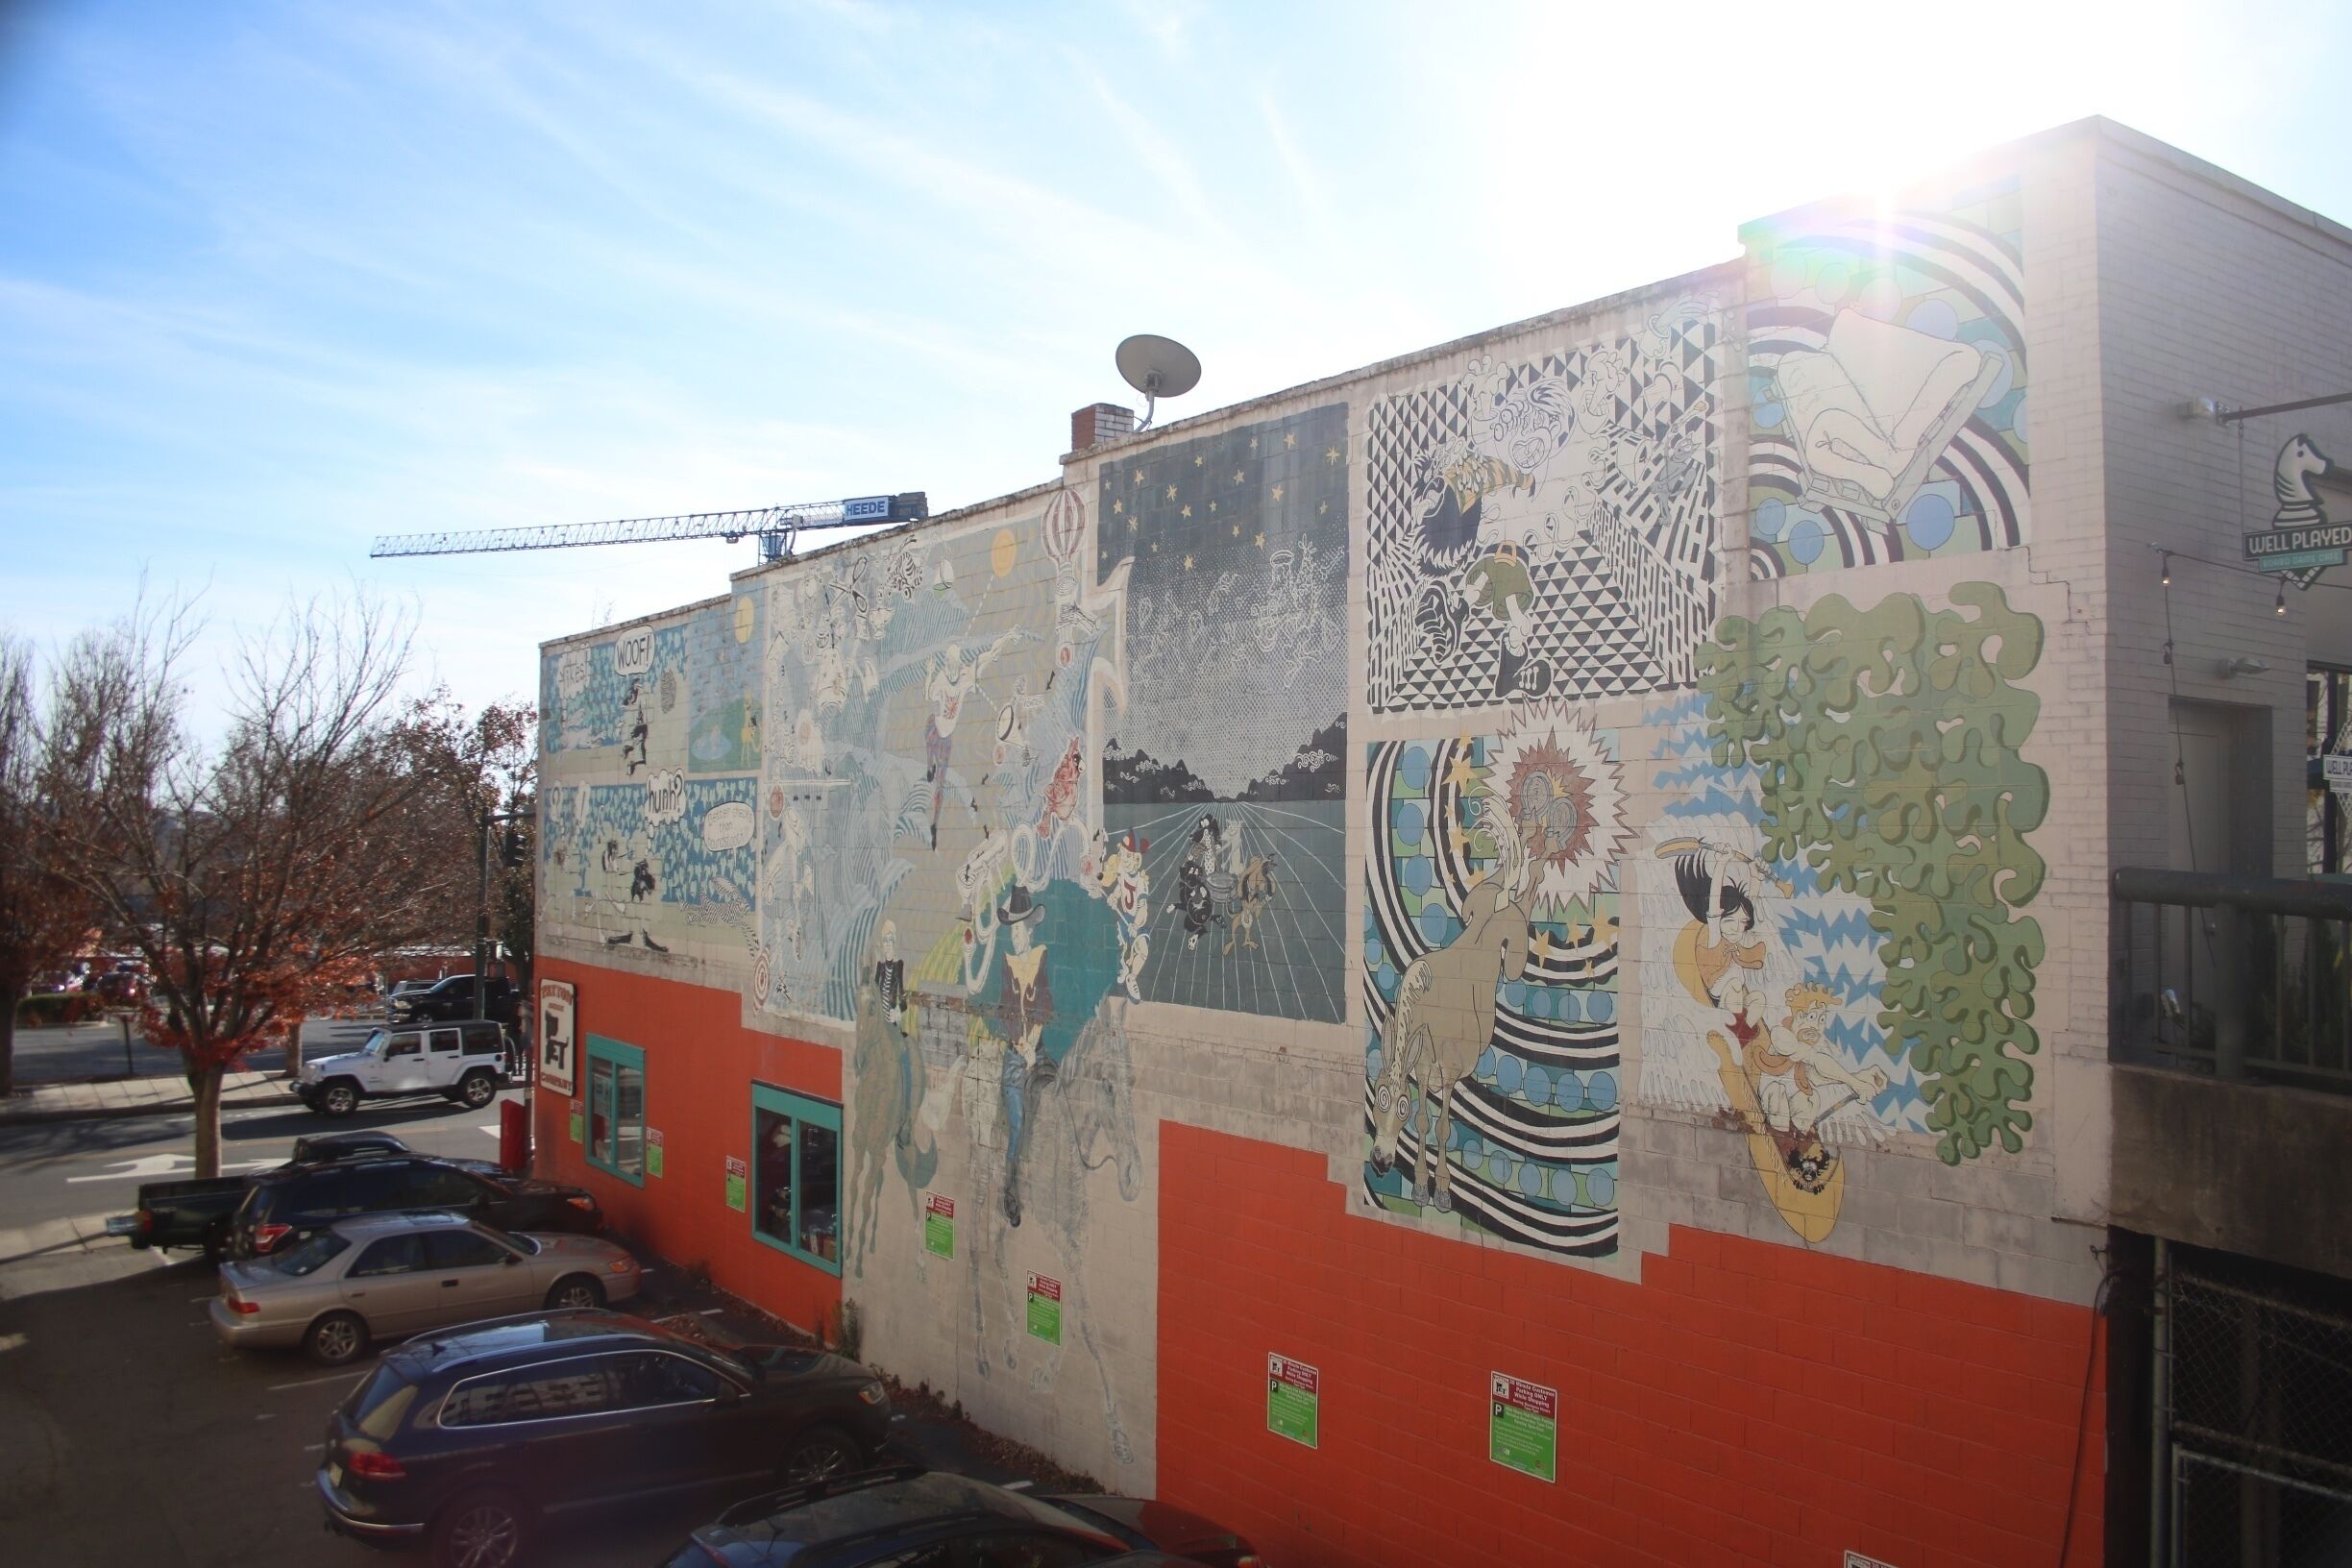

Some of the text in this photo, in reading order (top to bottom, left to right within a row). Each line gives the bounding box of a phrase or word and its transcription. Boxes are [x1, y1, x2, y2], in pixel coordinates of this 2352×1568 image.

[846, 501, 886, 517] HEEDE
[2248, 527, 2352, 554] WELL PLAYED
[616, 634, 650, 670] WOOF!
[1123, 878, 1138, 910] J
[1271, 1381, 1277, 1391] P
[1515, 1386, 1548, 1401] Parking ONLY
[1495, 1404, 1503, 1415] P
[1528, 1396, 1550, 1409] Shopping
